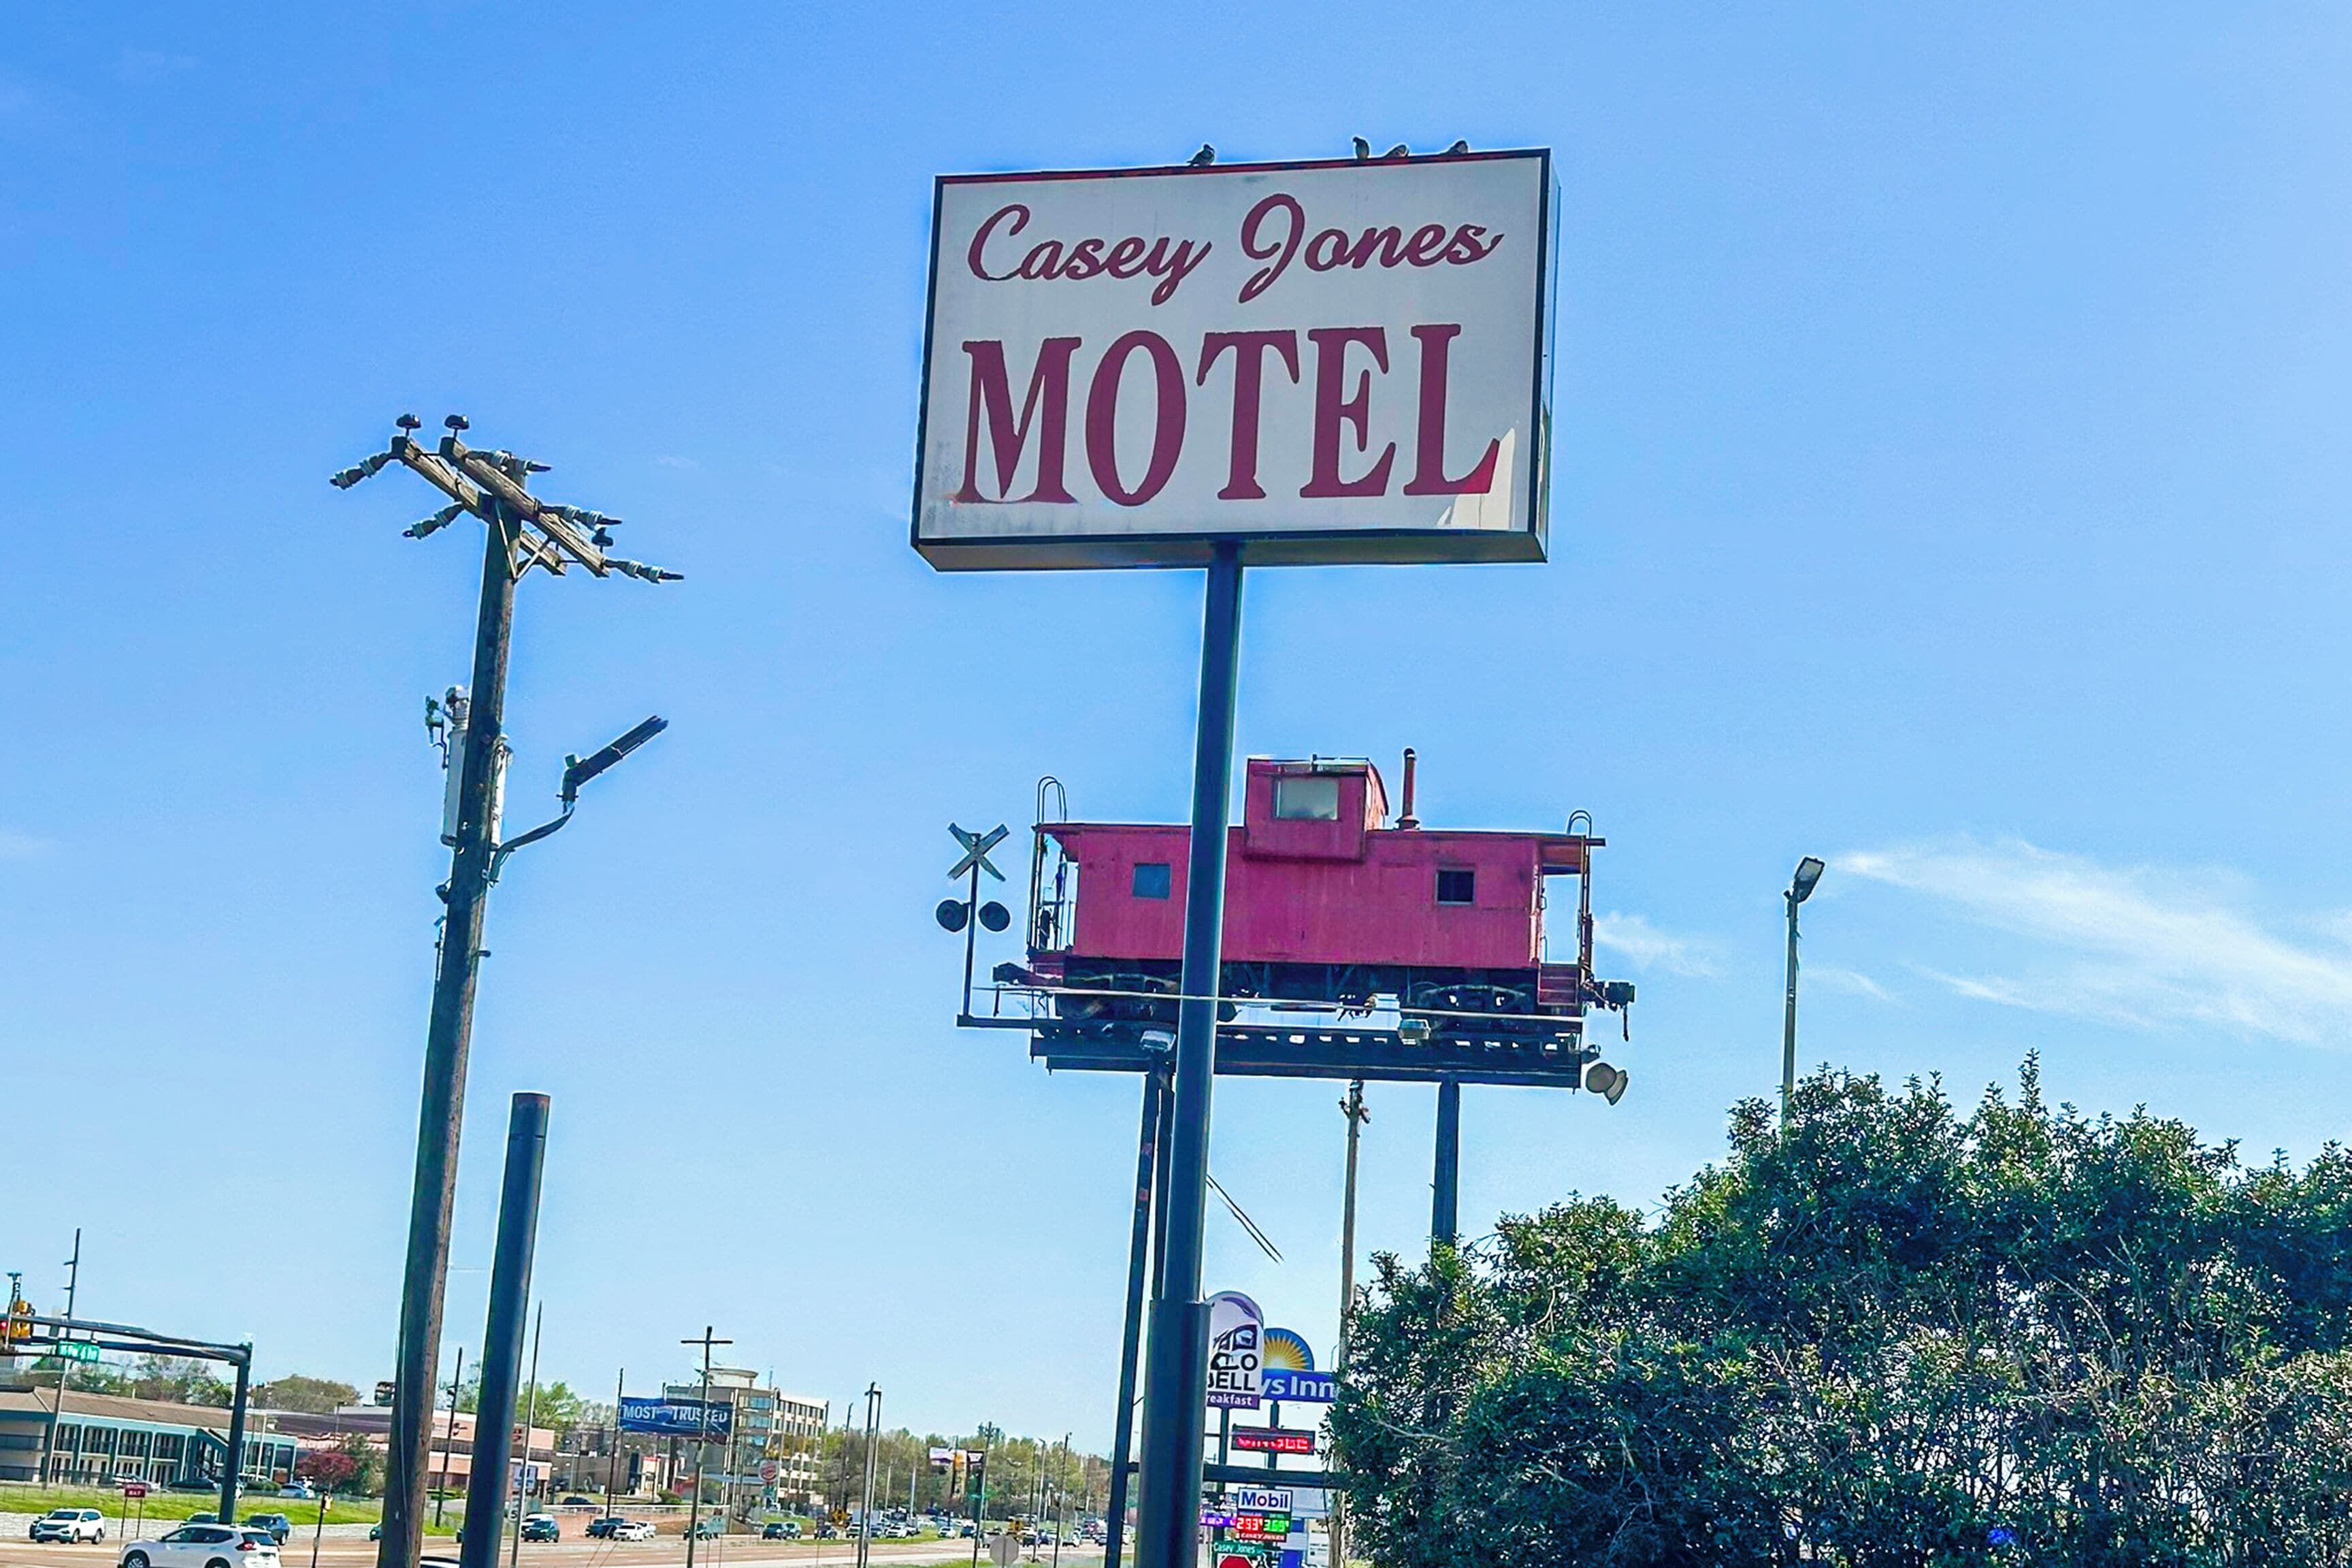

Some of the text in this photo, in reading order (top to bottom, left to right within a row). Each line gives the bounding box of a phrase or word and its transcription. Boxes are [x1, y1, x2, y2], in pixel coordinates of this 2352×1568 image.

[967, 193, 1505, 306] Casey Jones
[953, 323, 1500, 506] MOTEL
[1261, 1376, 1335, 1398] ys Inn
[1207, 1393, 1252, 1405] reakfast
[622, 1405, 657, 1419] MOST
[1241, 1492, 1288, 1507] Mobil
